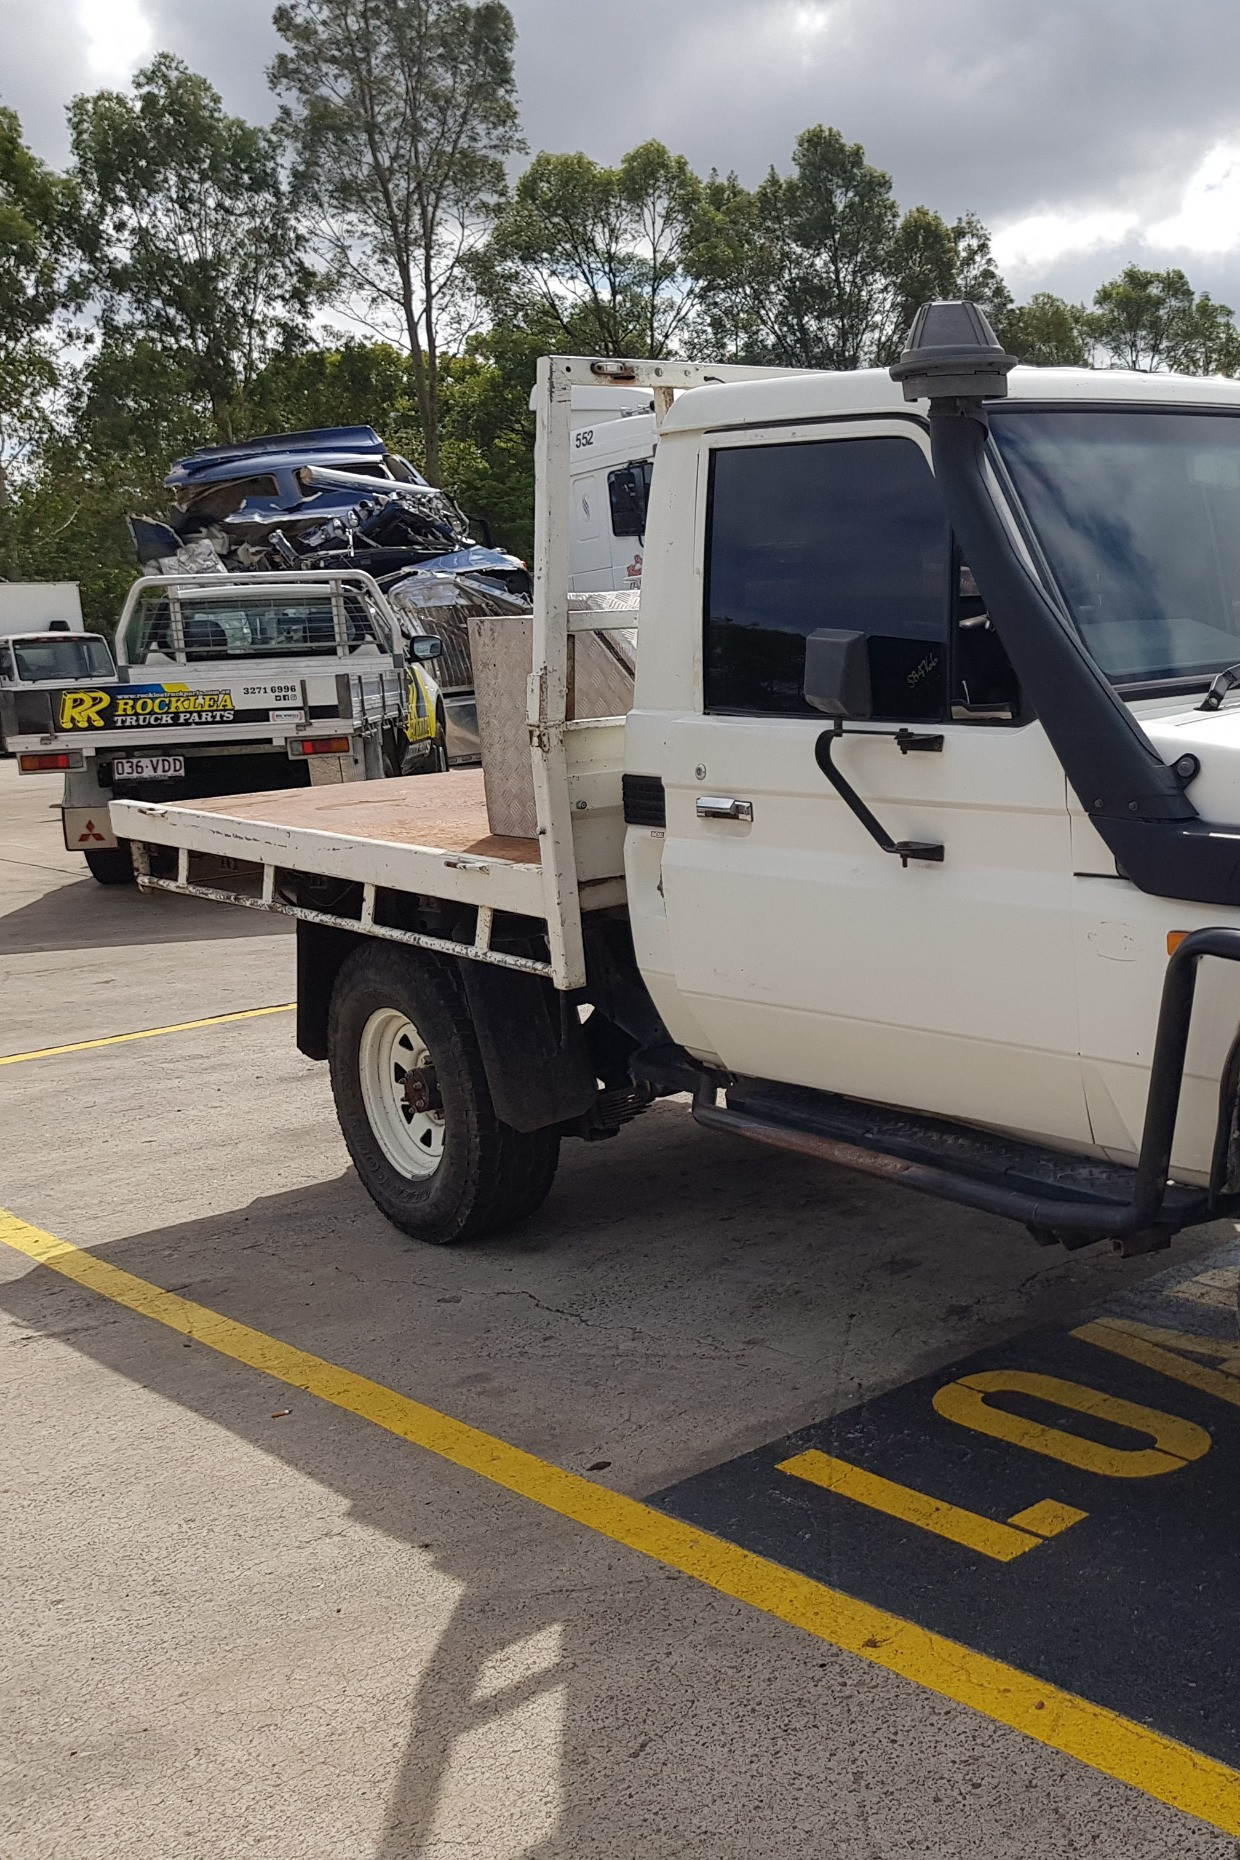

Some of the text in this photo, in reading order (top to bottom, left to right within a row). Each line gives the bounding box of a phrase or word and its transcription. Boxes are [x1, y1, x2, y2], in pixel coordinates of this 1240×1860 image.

[575, 430, 594, 448] 552
[243, 685, 296, 695] 3271 6996
[115, 694, 235, 716] ROCKLEA
[114, 710, 235, 727] TRUCK PARTS
